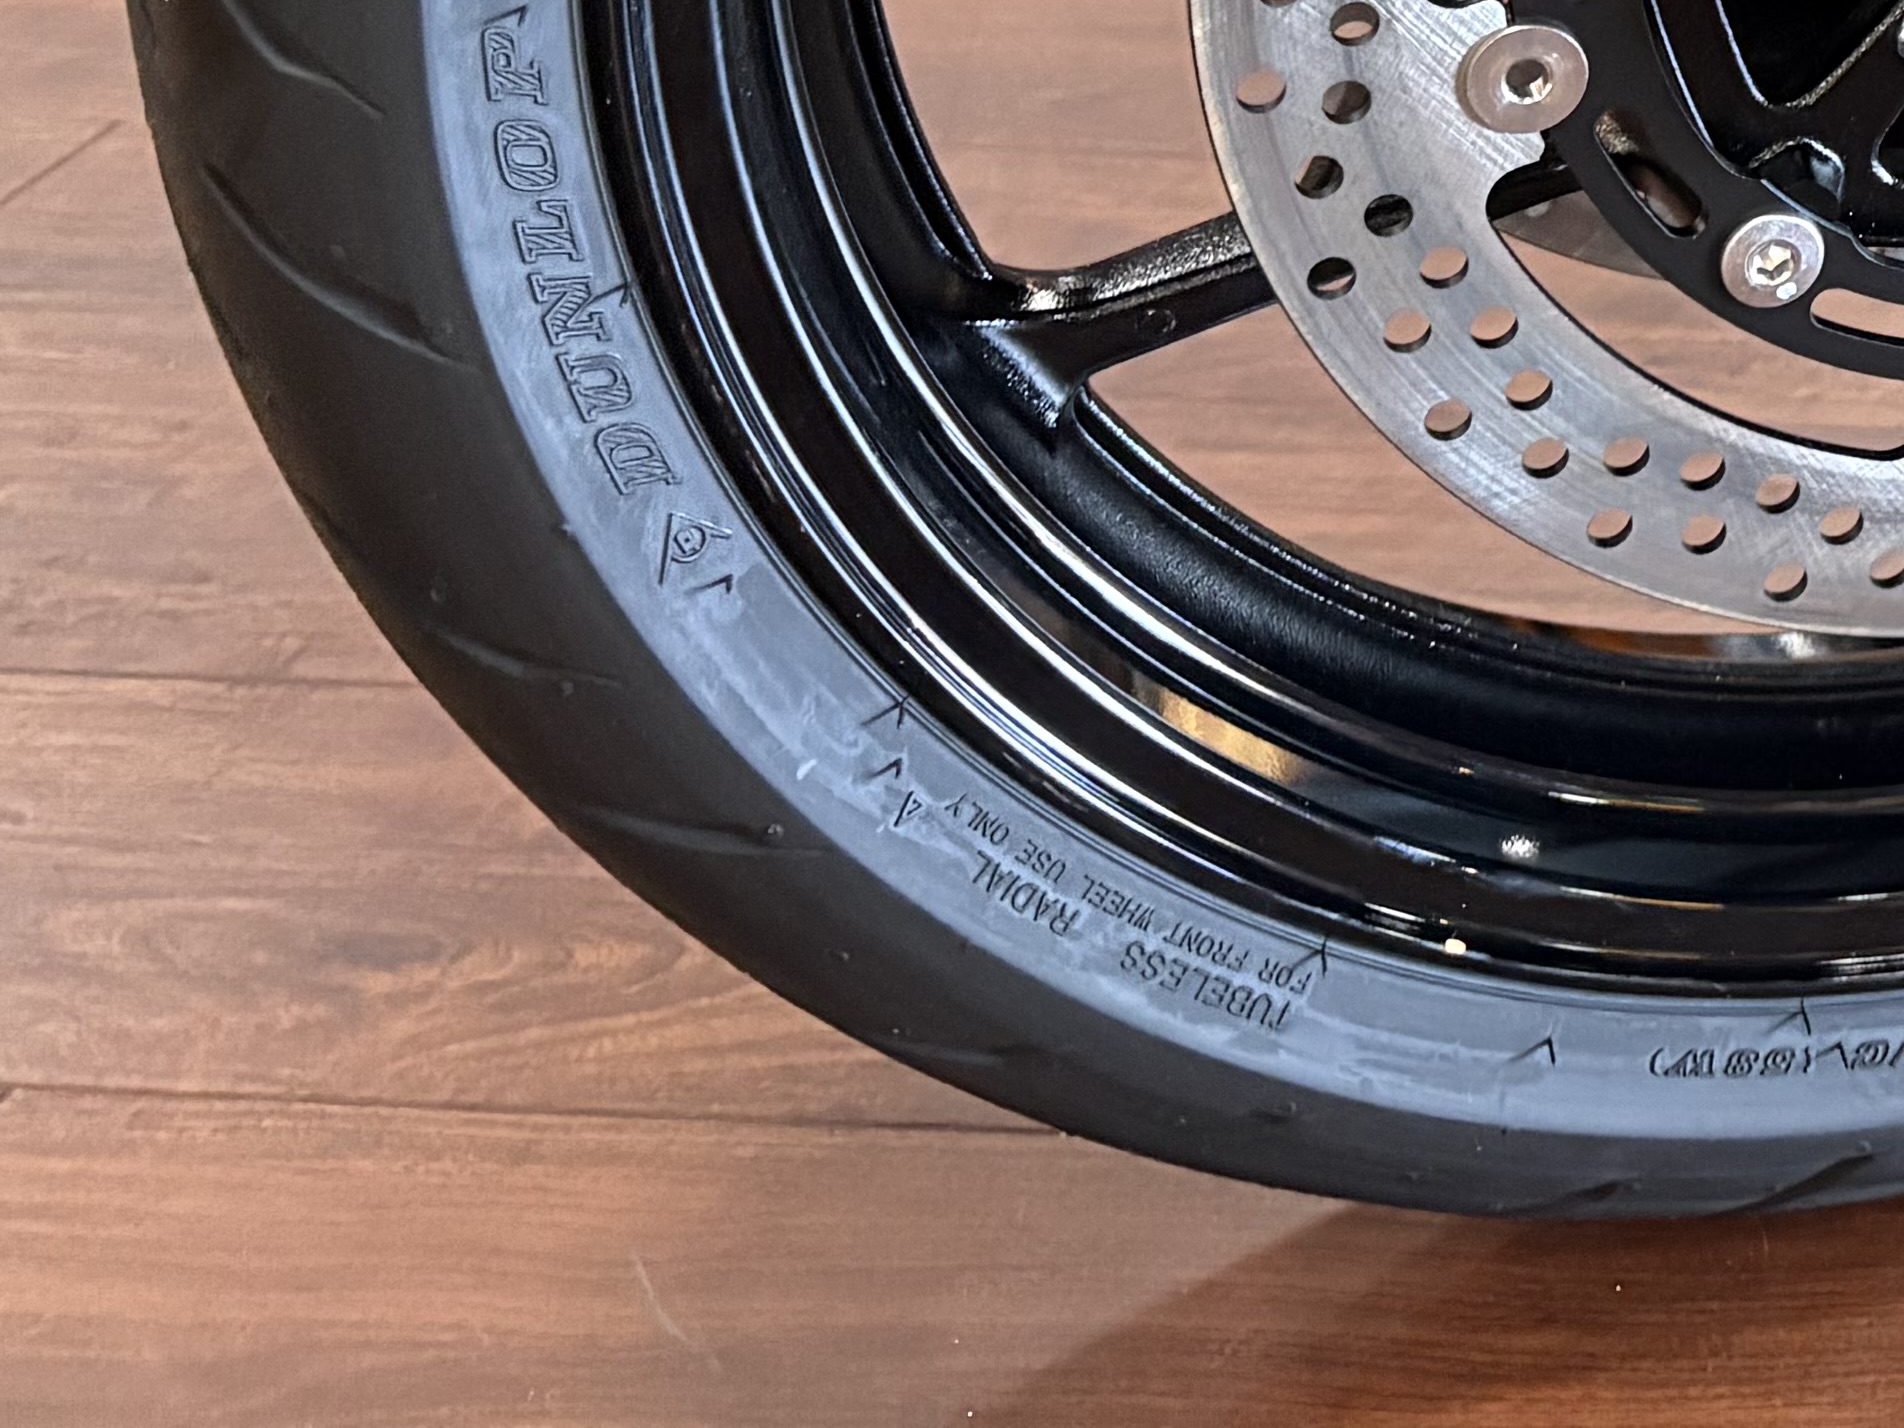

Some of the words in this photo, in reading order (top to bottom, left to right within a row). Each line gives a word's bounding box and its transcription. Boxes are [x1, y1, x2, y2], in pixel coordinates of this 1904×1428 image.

[480, 24, 682, 497] DUNLOP
[943, 791, 1010, 846] ONLY
[1014, 838, 1068, 884] USE
[970, 849, 1083, 938] RADIAL
[1082, 873, 1157, 932] WHEEL
[1163, 921, 1251, 973] FRONT
[1119, 941, 1293, 1033] TUBELESS
[1258, 956, 1314, 997] FOR
